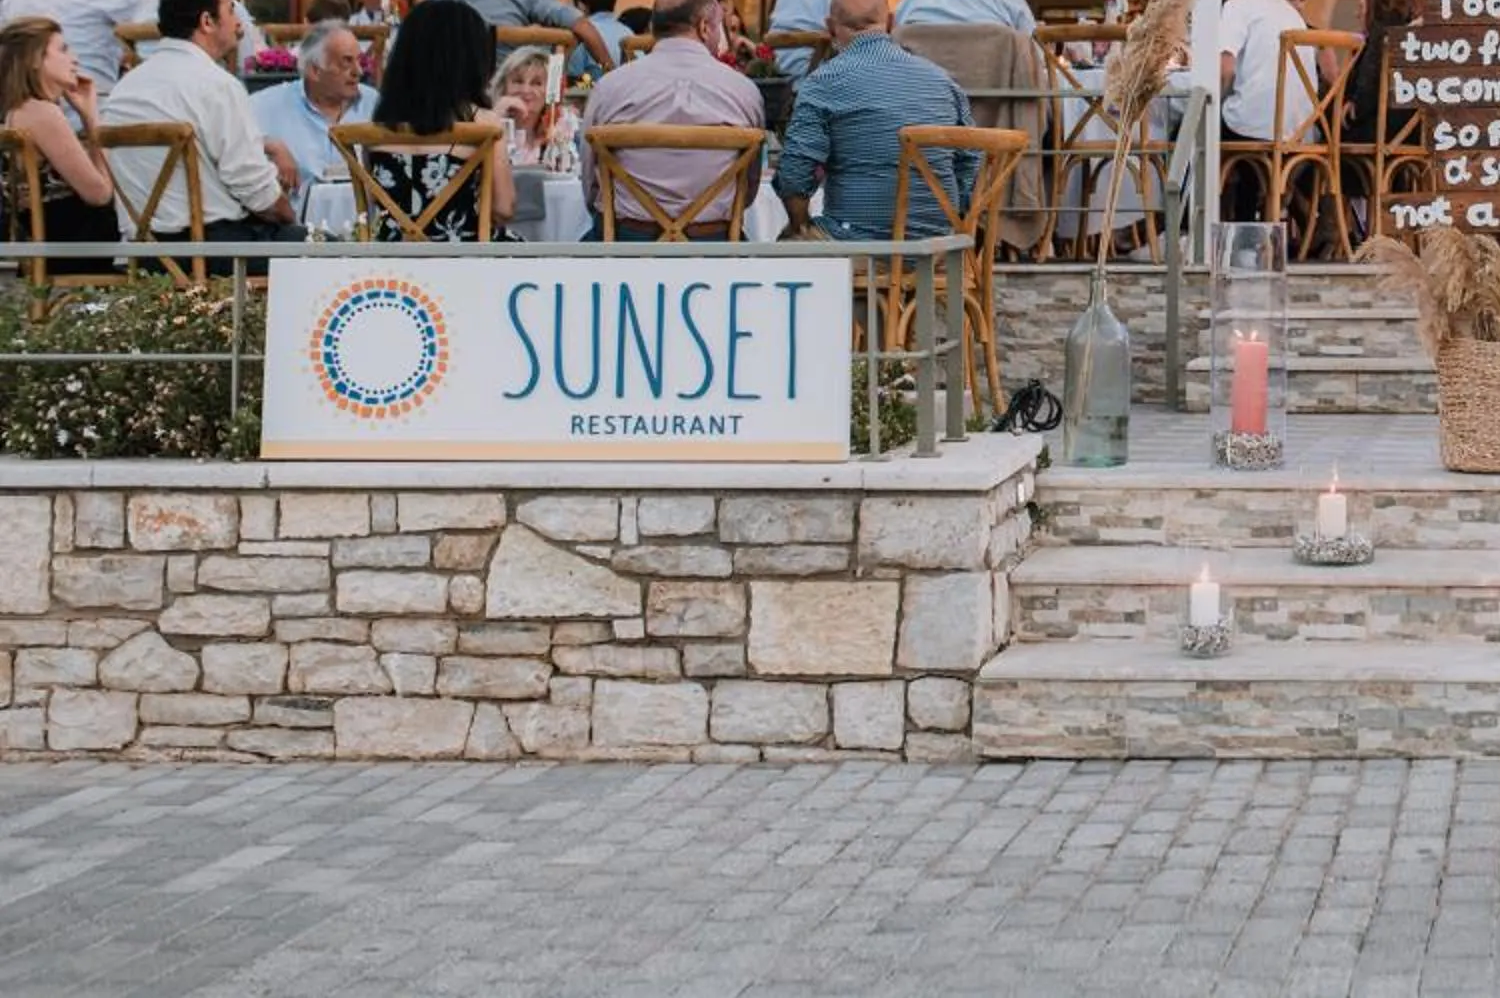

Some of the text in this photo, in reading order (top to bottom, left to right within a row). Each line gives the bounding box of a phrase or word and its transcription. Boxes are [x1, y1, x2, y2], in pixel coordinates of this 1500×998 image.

[1401, 32, 1471, 62] two
[1433, 121, 1480, 150] so
[1444, 156, 1471, 183] a
[1390, 196, 1452, 228] not
[1466, 202, 1499, 227] a
[503, 282, 813, 400] SUNSET
[571, 415, 743, 435] RESTAURANT
